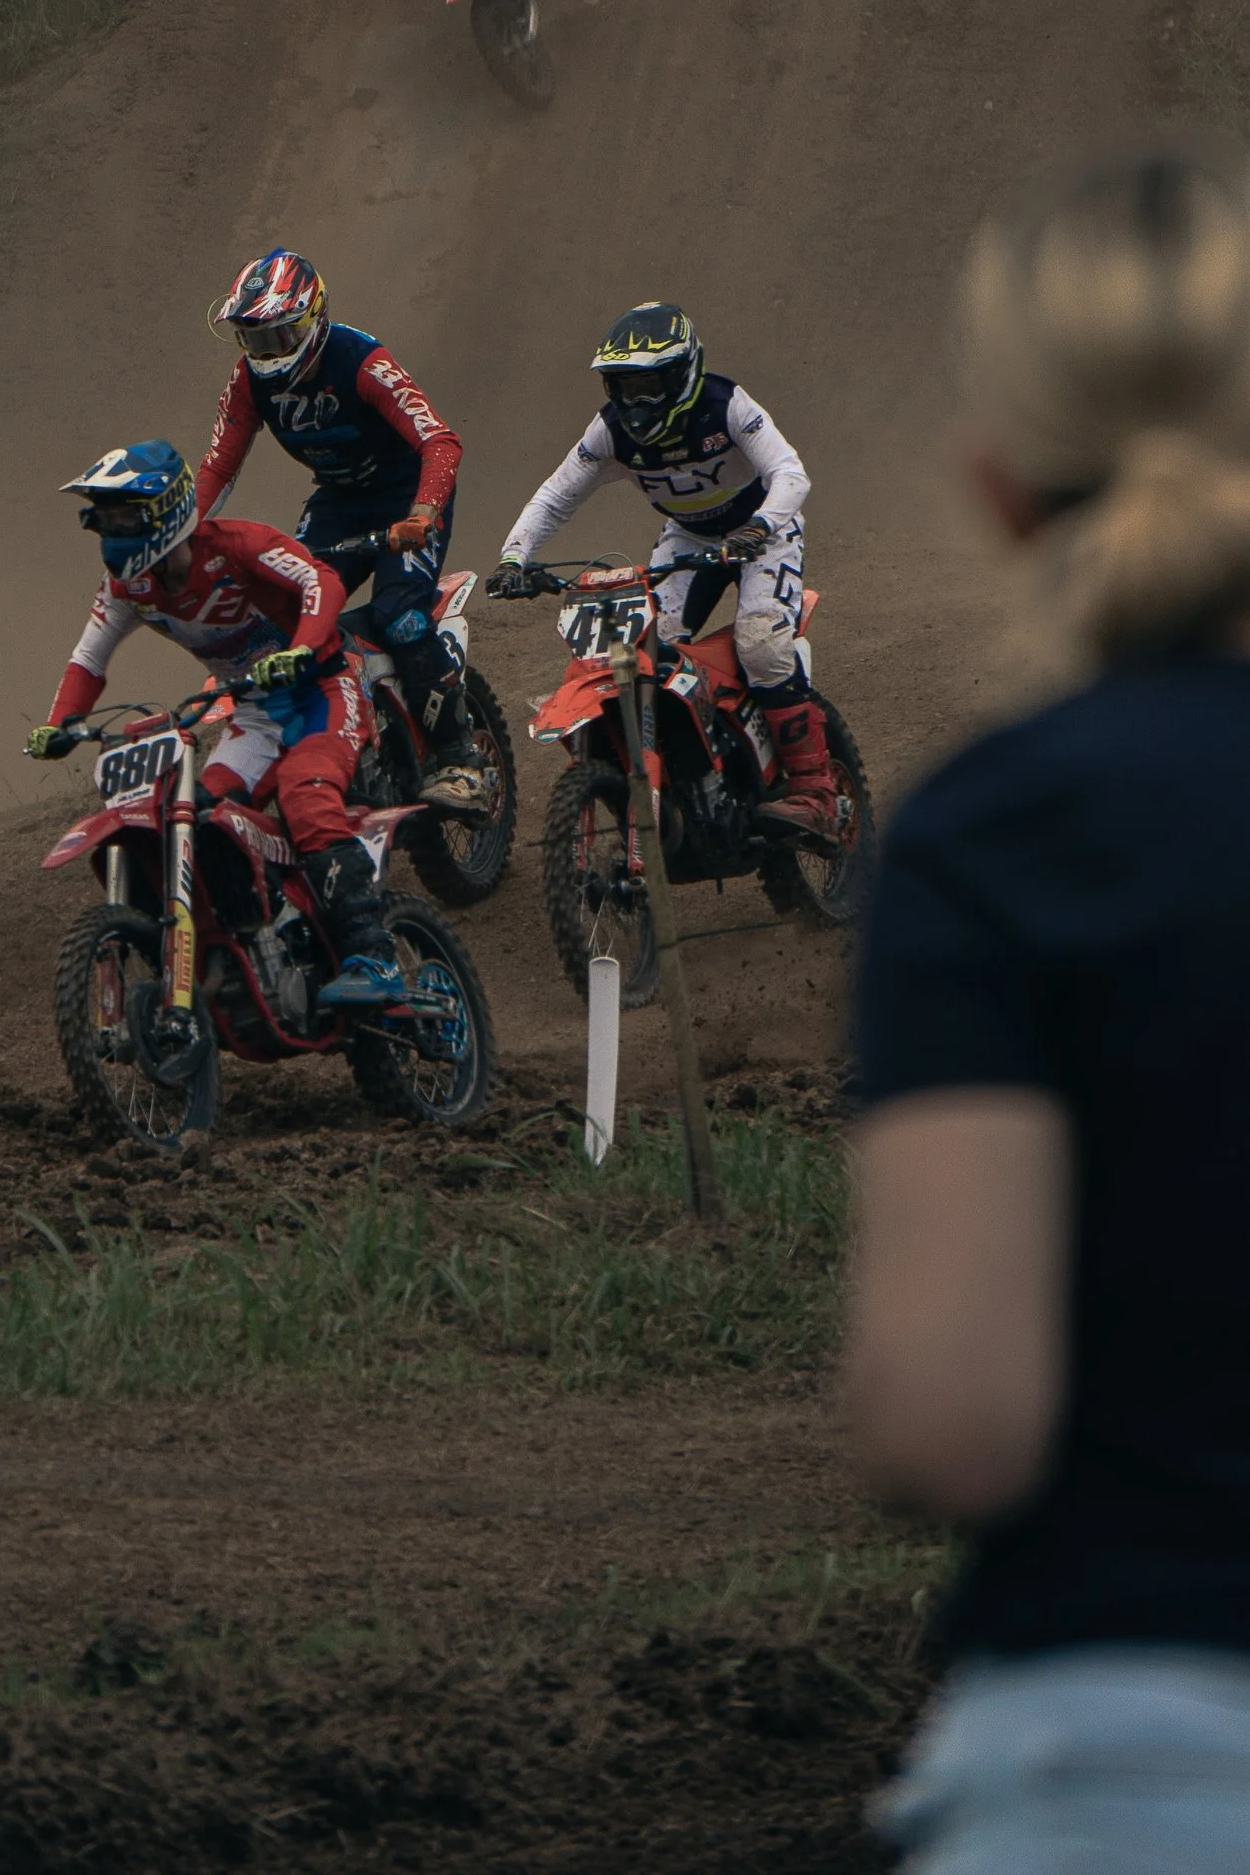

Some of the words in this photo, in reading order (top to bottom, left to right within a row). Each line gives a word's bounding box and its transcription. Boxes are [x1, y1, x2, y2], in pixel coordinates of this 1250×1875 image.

[270, 391, 340, 432] TLD
[638, 460, 726, 496] FLY
[100, 736, 178, 797] 880
[175, 929, 192, 993] PIRELLI
